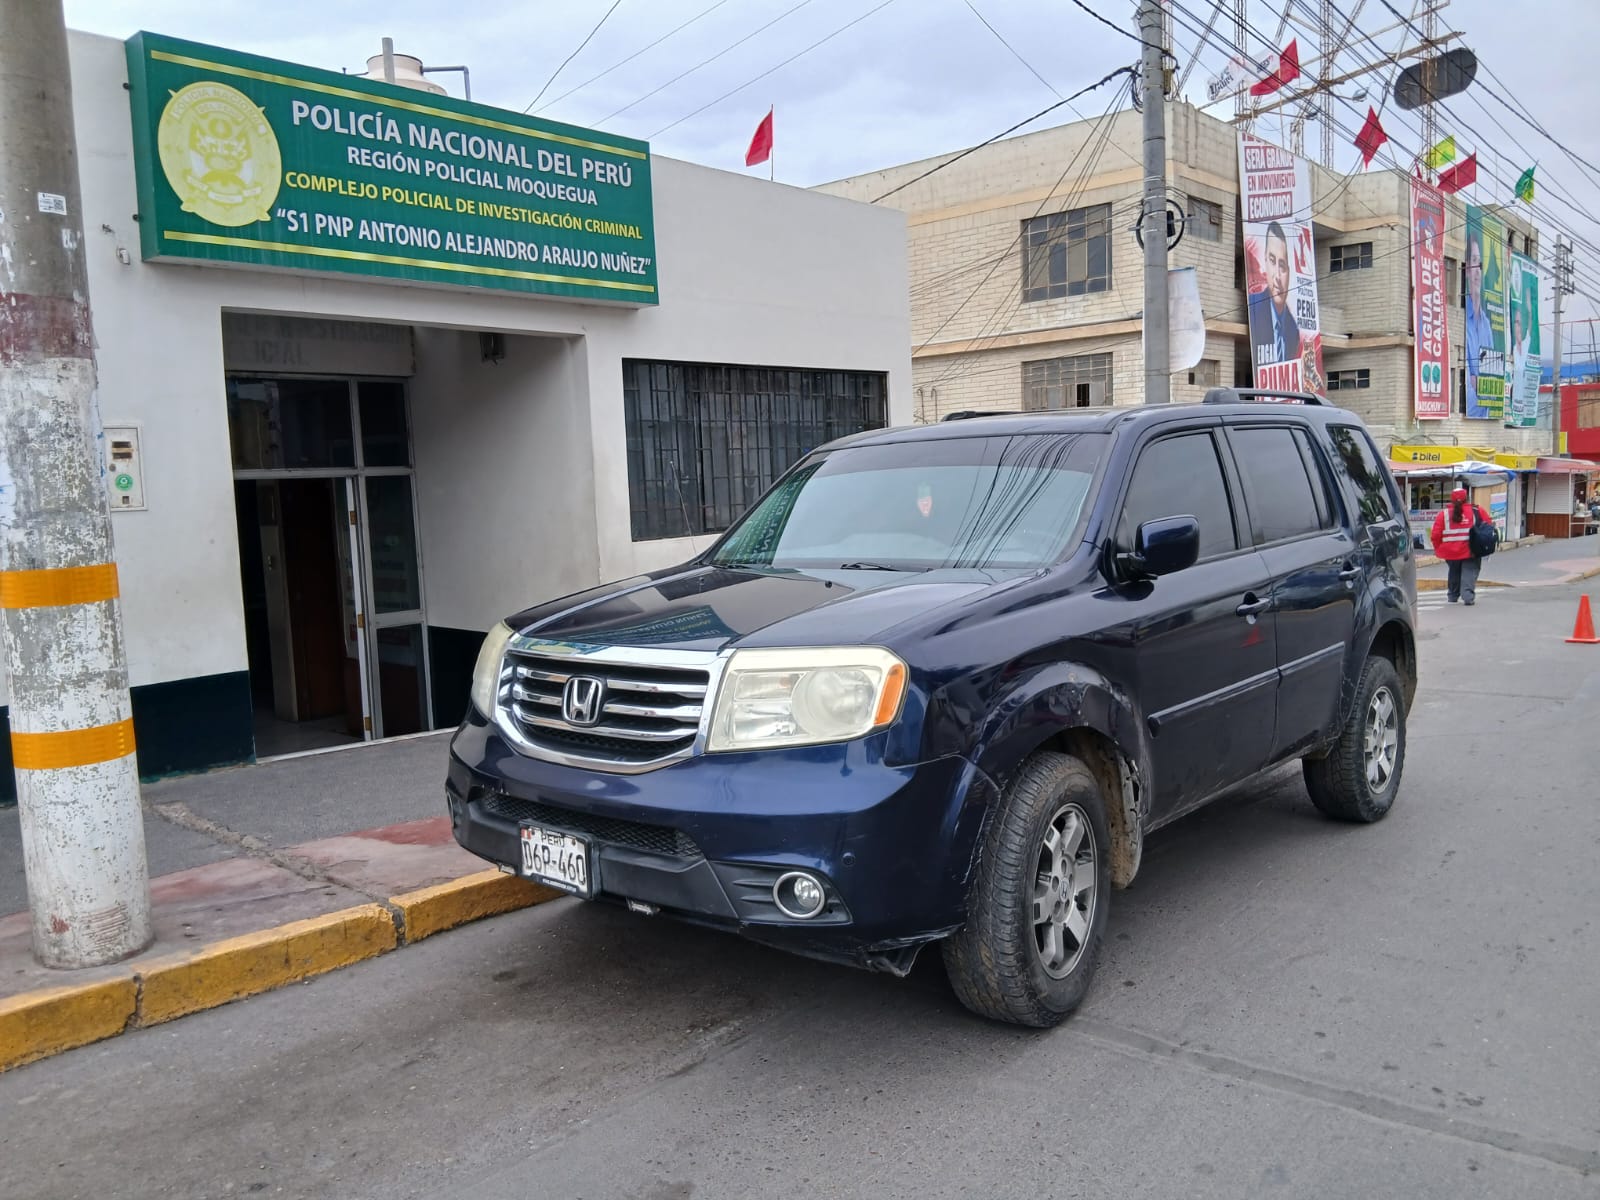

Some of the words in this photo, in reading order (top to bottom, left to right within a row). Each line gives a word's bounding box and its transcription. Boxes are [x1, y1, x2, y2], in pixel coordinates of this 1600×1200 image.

[292, 100, 402, 144] POLICÍA
[408, 123, 533, 170] NACIONAL
[537, 149, 577, 178] DEL
[582, 158, 632, 188] PERÚ
[347, 146, 420, 176] REGIÓN
[425, 160, 503, 190] POLICIAL
[507, 175, 598, 206] MOQUEGUA
[1247, 175, 1256, 192] EN
[1258, 172, 1296, 191] MOVIMIENTO
[285, 171, 378, 200] COMPLEJO
[382, 186, 453, 211] POLICIAL
[456, 199, 475, 215] DE
[479, 201, 582, 231] INVESTIGACIÓN
[585, 218, 643, 240] CRIMINAL
[315, 213, 354, 238] PNP
[358, 219, 441, 250] ANTONIO
[445, 231, 538, 262] ALEJANDRO
[542, 244, 598, 270] ARAUJO
[1421, 255, 1432, 286] DE
[1296, 298, 1316, 319] PERÚ
[1422, 293, 1432, 355] AGUA
[1432, 260, 1442, 357] CALIDAD
[1419, 452, 1441, 462] bitel
[522, 840, 586, 886] D6P-460
